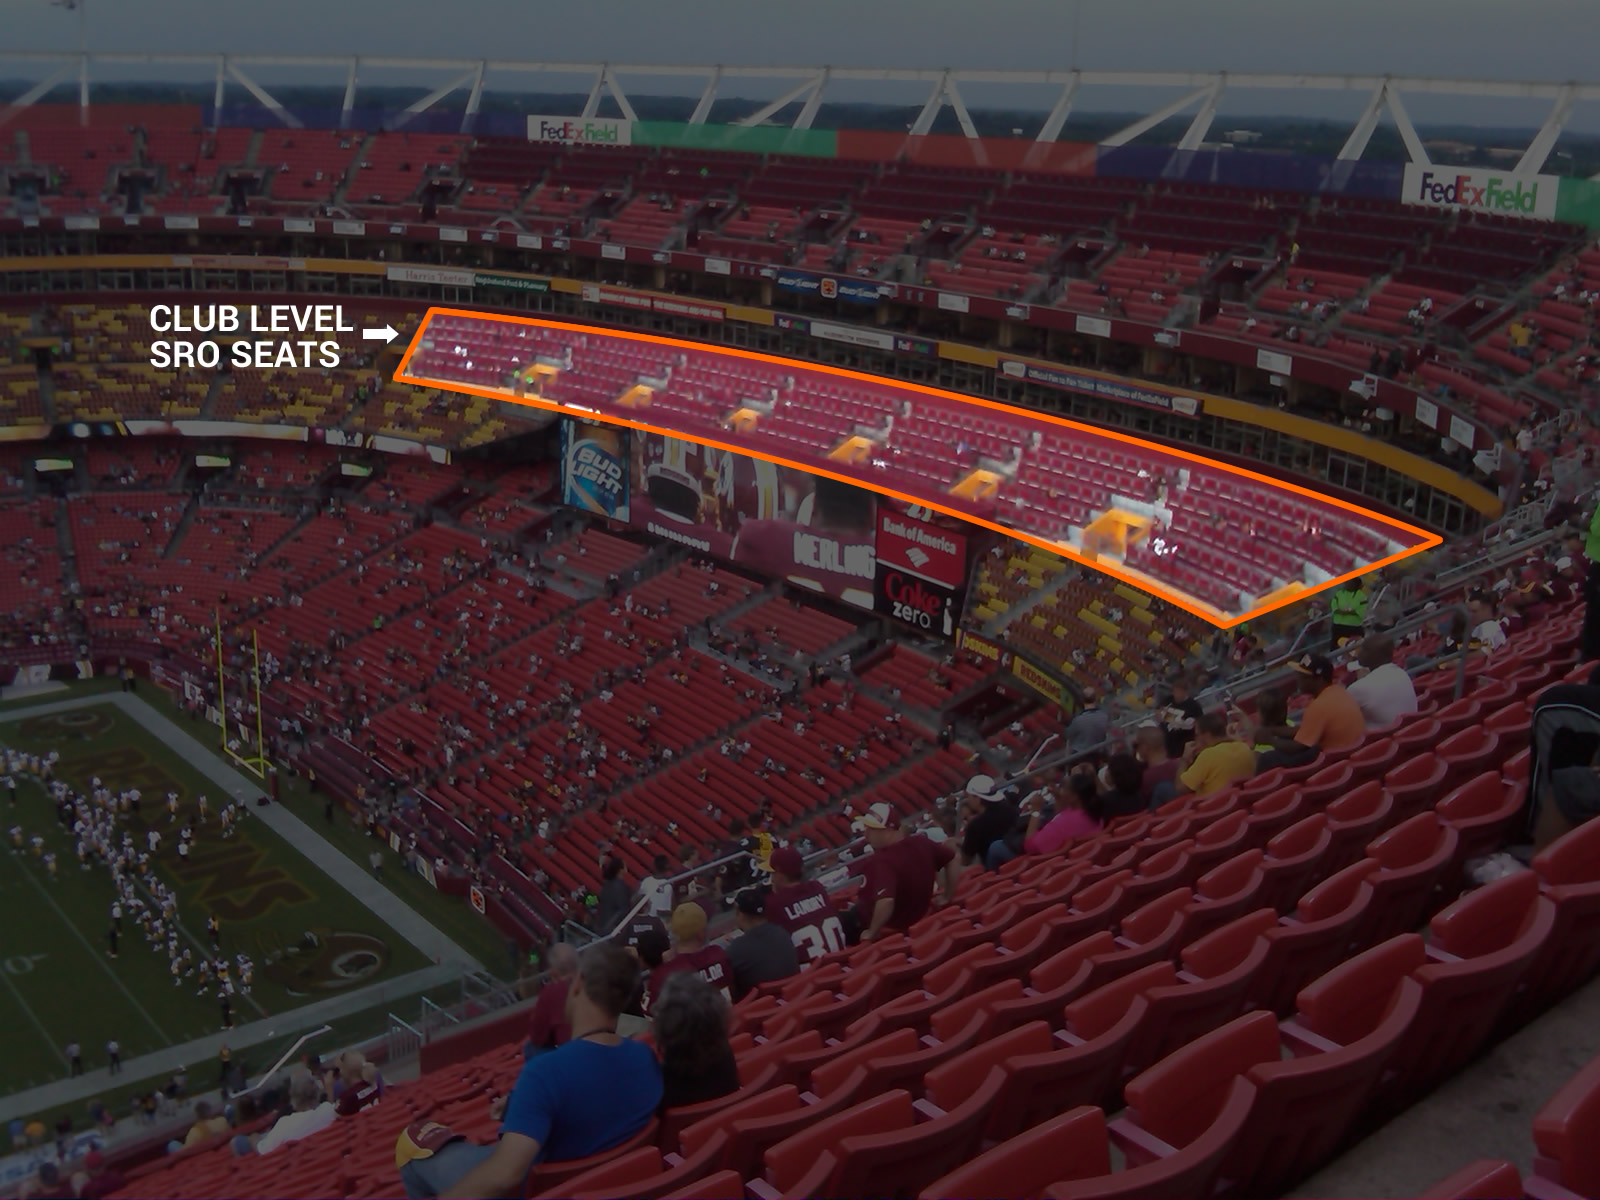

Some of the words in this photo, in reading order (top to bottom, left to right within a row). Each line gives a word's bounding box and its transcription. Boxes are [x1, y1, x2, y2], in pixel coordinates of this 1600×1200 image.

[540, 120, 618, 142] FedExField
[1420, 172, 1538, 213] FedExField
[405, 270, 435, 281] Harris
[437, 272, 468, 284] Teeter
[578, 447, 623, 480] BUD
[883, 517, 907, 537] Bank
[906, 526, 917, 540] of
[916, 528, 956, 555] America
[884, 571, 940, 616] Coke
[892, 601, 932, 629] zero
[784, 893, 827, 921] LANDRY
